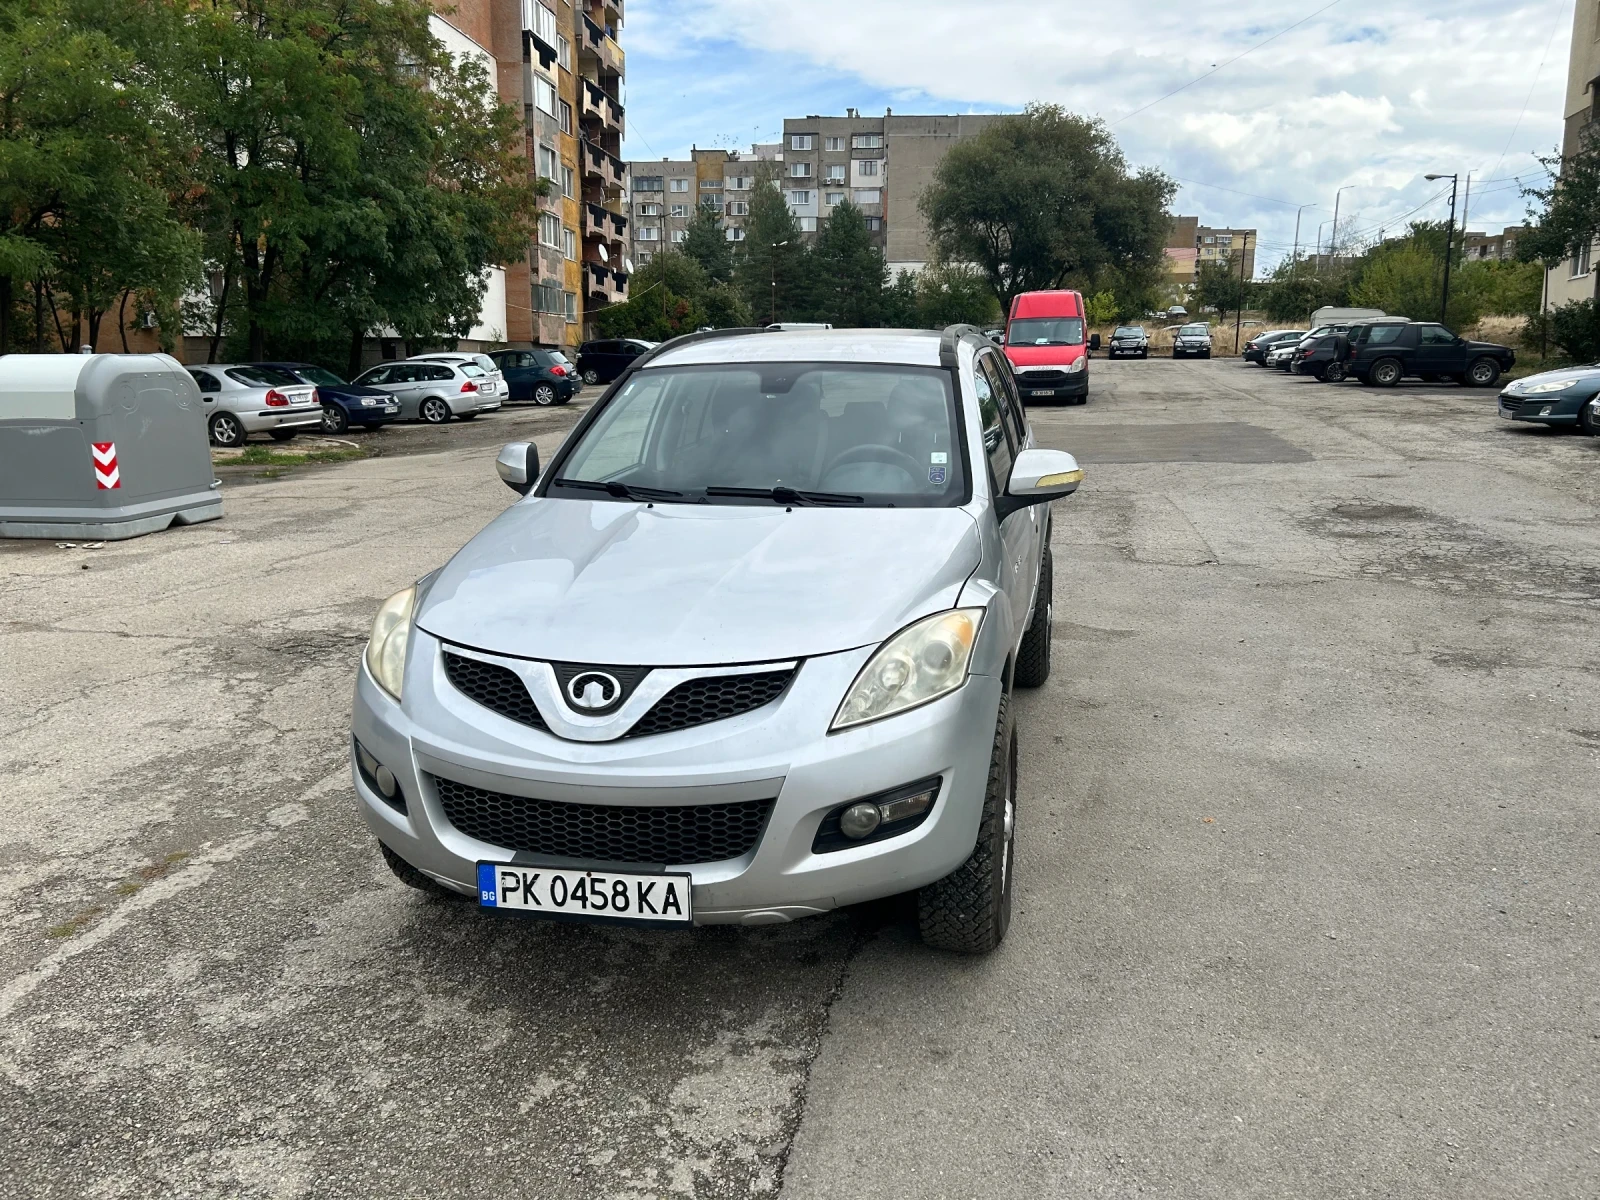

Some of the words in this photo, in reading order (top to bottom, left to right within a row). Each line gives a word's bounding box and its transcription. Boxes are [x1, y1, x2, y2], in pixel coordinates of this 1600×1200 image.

[482, 891, 495, 901] BG
[501, 871, 542, 905] PK
[550, 875, 630, 912] 0458
[637, 881, 682, 915] KA
